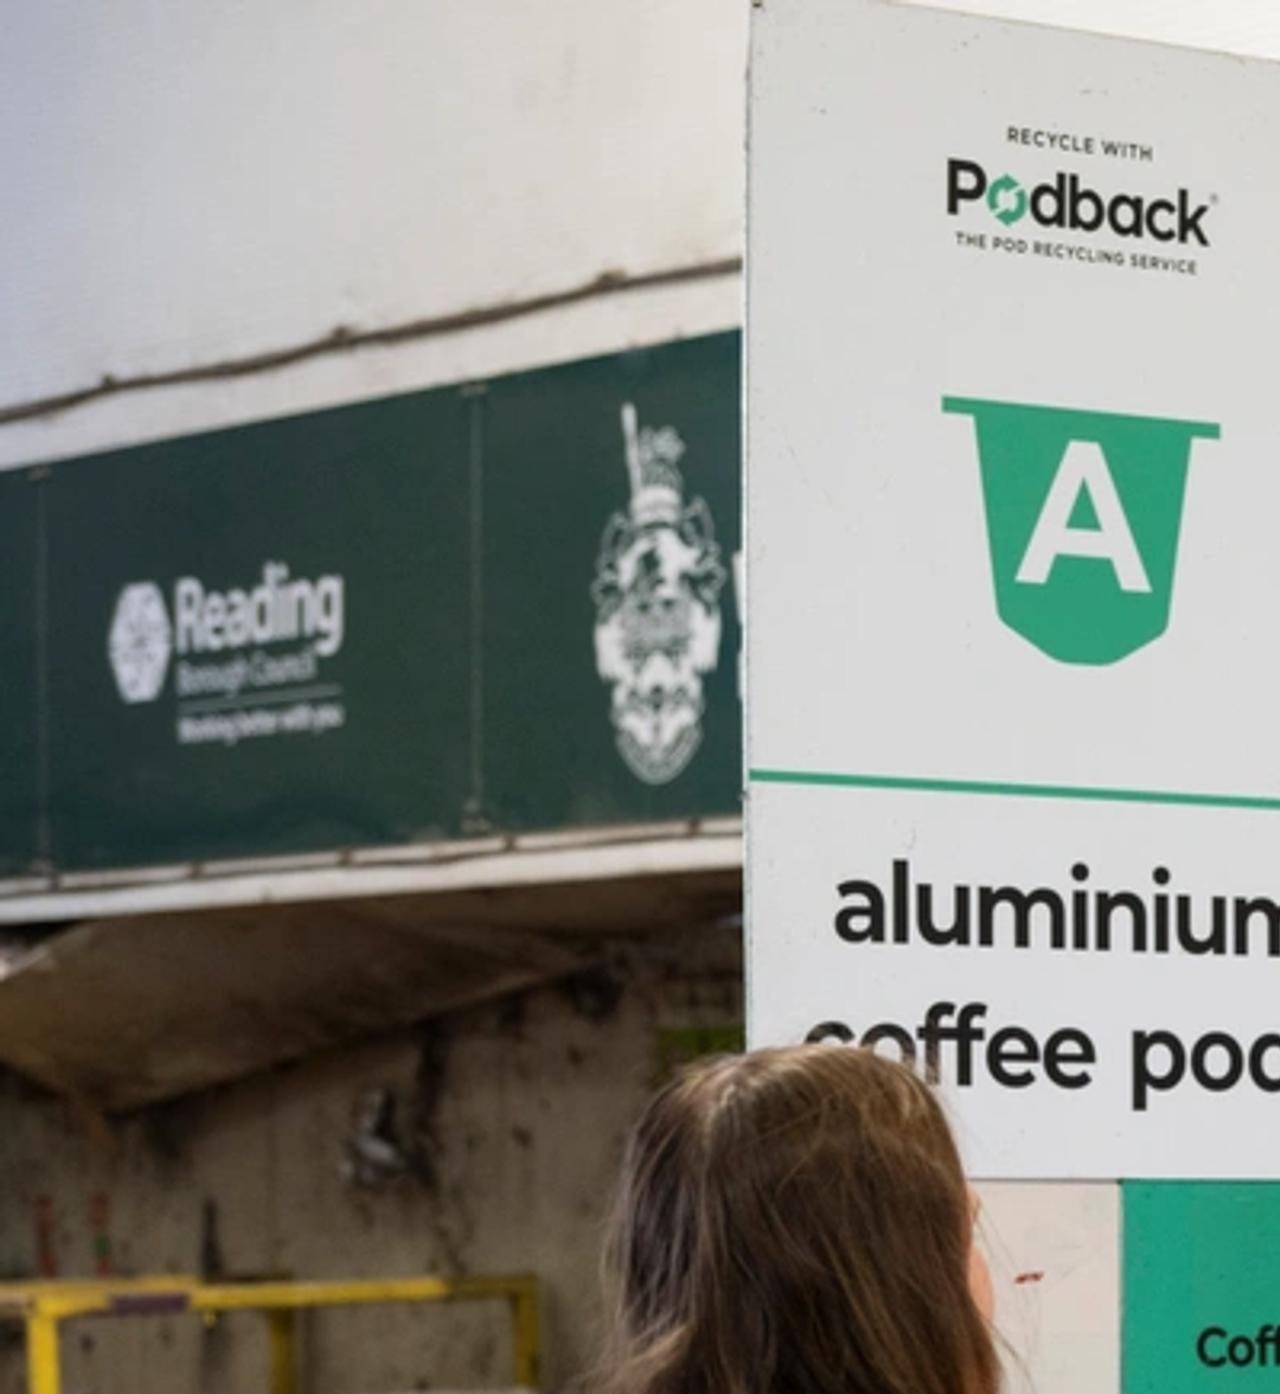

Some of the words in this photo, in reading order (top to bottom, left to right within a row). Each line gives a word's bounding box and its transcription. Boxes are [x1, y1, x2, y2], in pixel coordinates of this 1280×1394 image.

[1007, 126, 1095, 155] RECYCLE
[1101, 140, 1153, 162] WITH
[947, 157, 1211, 247] Podback
[955, 231, 987, 251] THE
[992, 236, 1029, 255] POD
[1033, 241, 1125, 267] RECYCLING
[1130, 253, 1198, 275] SERVICE
[1014, 439, 1153, 594] A
[175, 560, 344, 658] Reading
